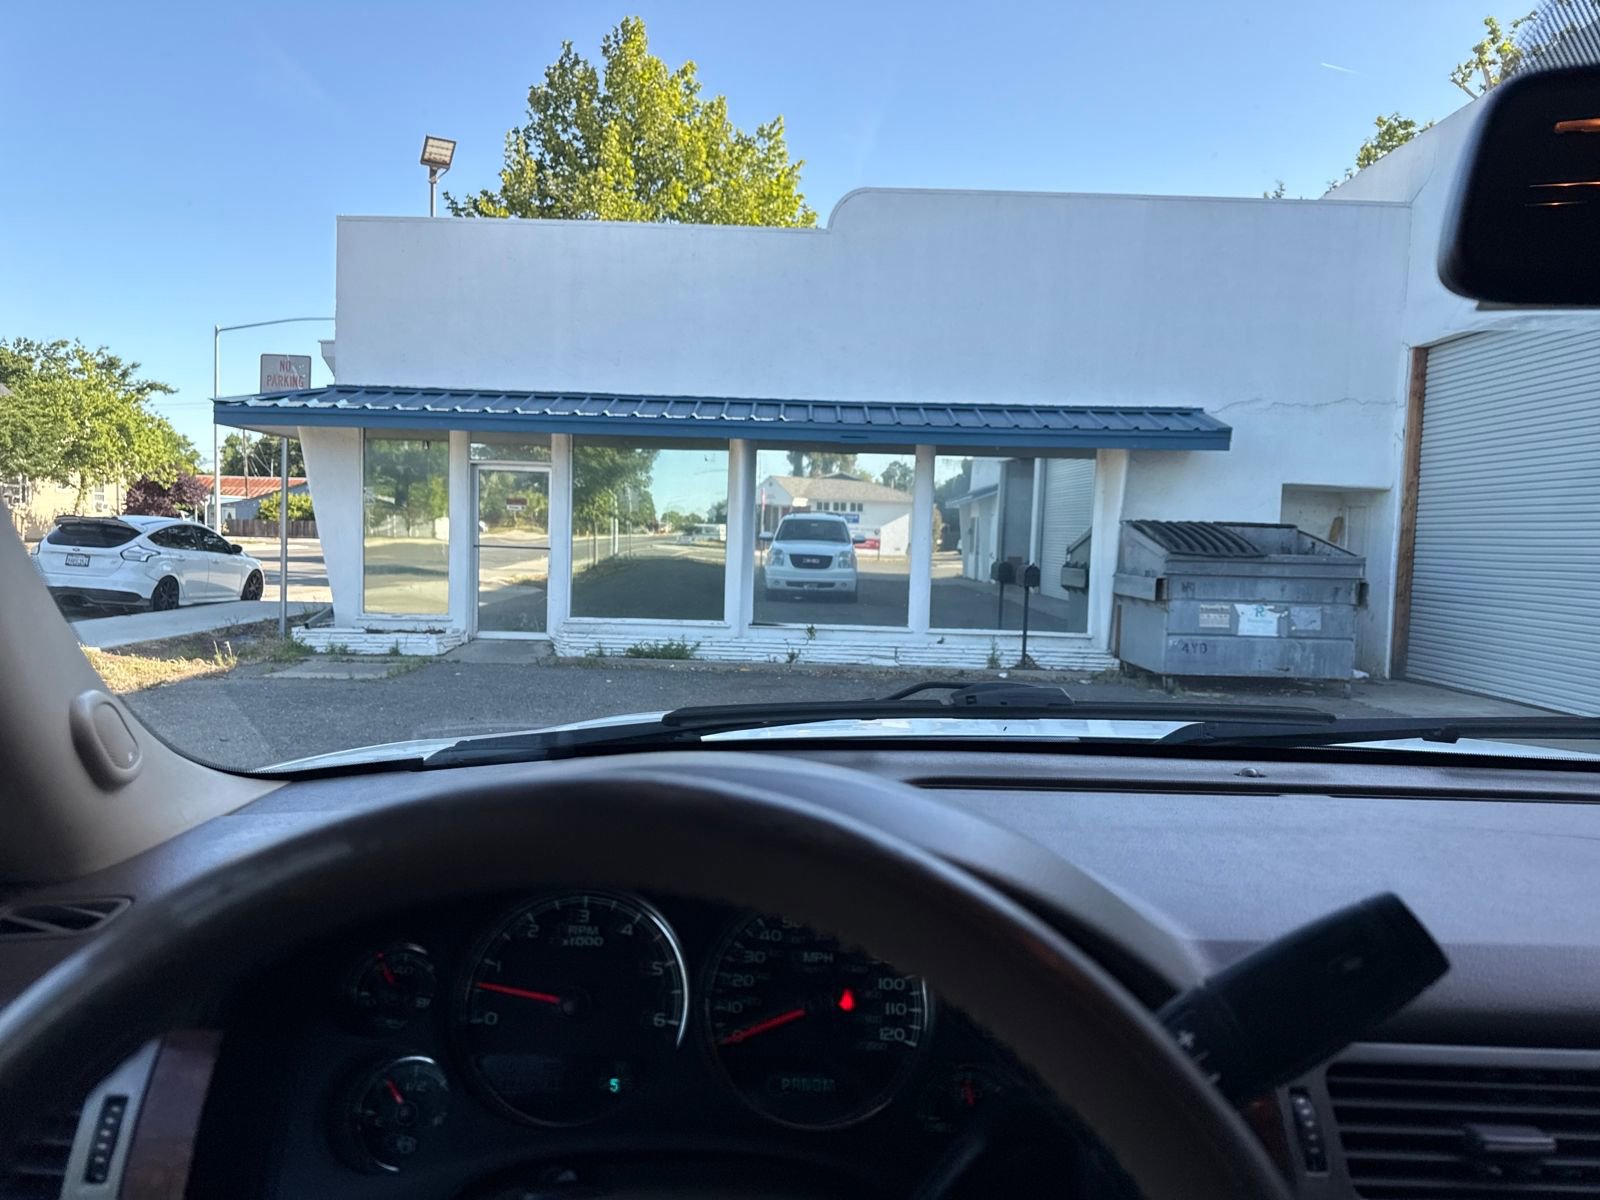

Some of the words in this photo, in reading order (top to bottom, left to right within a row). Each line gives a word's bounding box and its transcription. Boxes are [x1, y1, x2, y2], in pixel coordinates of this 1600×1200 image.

[280, 360, 292, 372] NO
[266, 375, 304, 388] PARKING
[579, 911, 590, 923] 3
[529, 925, 540, 938] 2
[568, 925, 600, 935] RPM
[620, 924, 633, 936] 4
[760, 930, 783, 942] 40
[743, 952, 767, 964] 30
[803, 952, 834, 964] MPH
[650, 963, 664, 976] 5
[732, 974, 755, 987] 20
[878, 977, 906, 991] 100
[728, 1001, 744, 1014] 10
[885, 1002, 908, 1016] 110
[484, 1011, 499, 1026] 0
[653, 1013, 667, 1028] 6
[880, 1027, 906, 1042] 120
